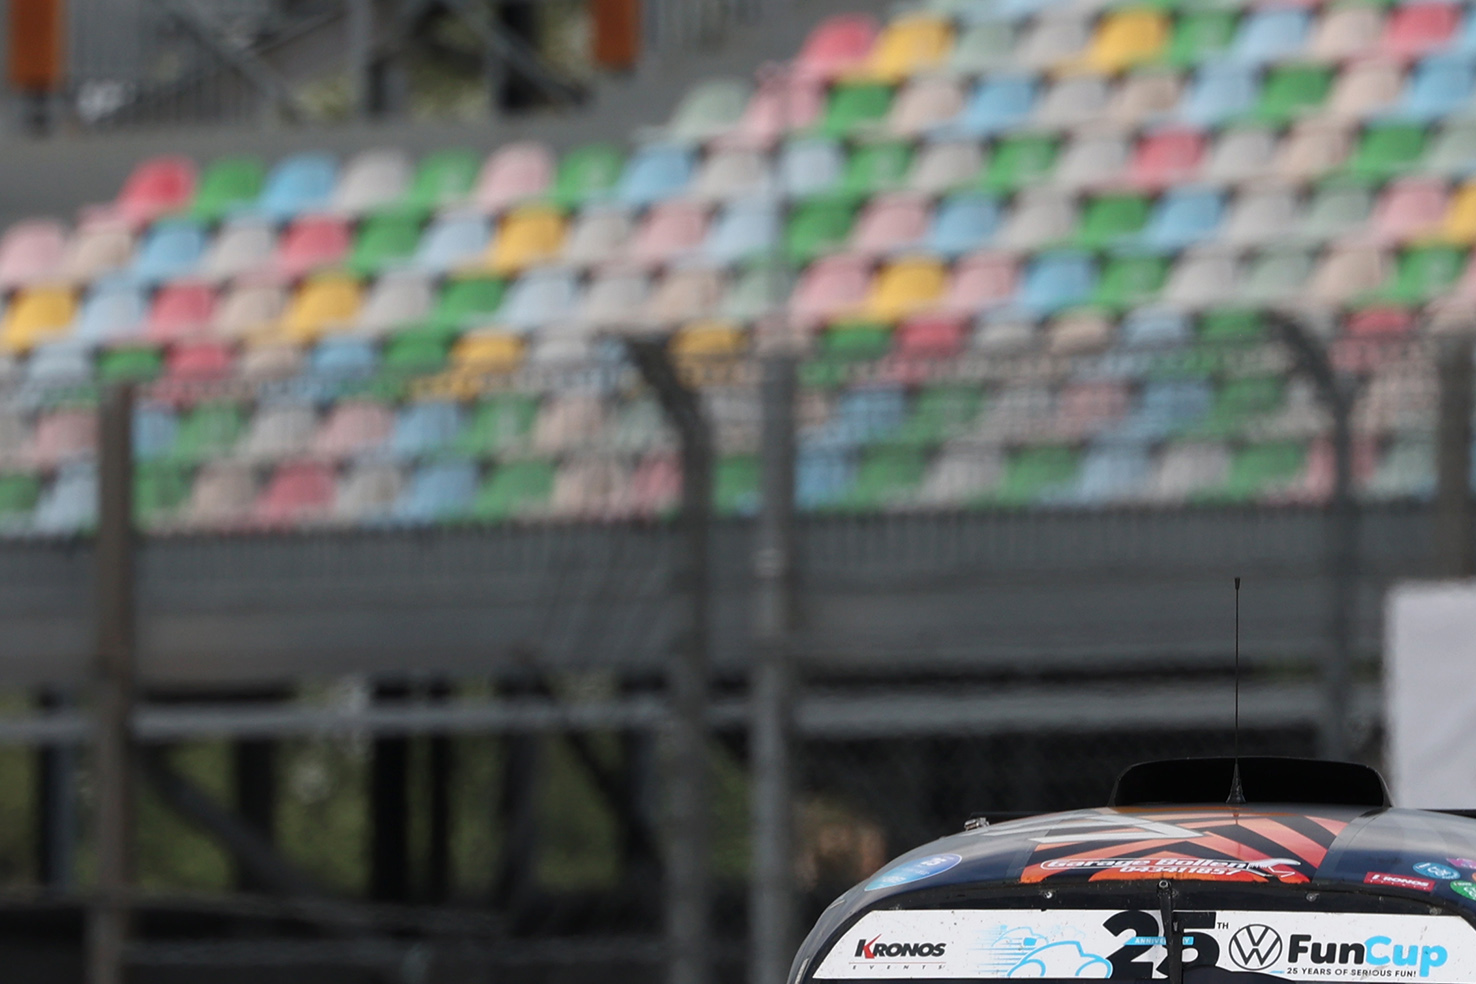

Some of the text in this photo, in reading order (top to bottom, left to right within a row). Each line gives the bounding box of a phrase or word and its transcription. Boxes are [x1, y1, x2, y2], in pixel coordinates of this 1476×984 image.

[1155, 858, 1249, 870] Bollen
[854, 933, 947, 959] KRONOS
[1102, 910, 1221, 979] 25
[1287, 934, 1448, 978] FunCup
[1301, 967, 1332, 976] YEARS
[1335, 968, 1348, 976] OF
[1350, 969, 1393, 978] SERIOUS
[1395, 970, 1417, 978] FUN!
